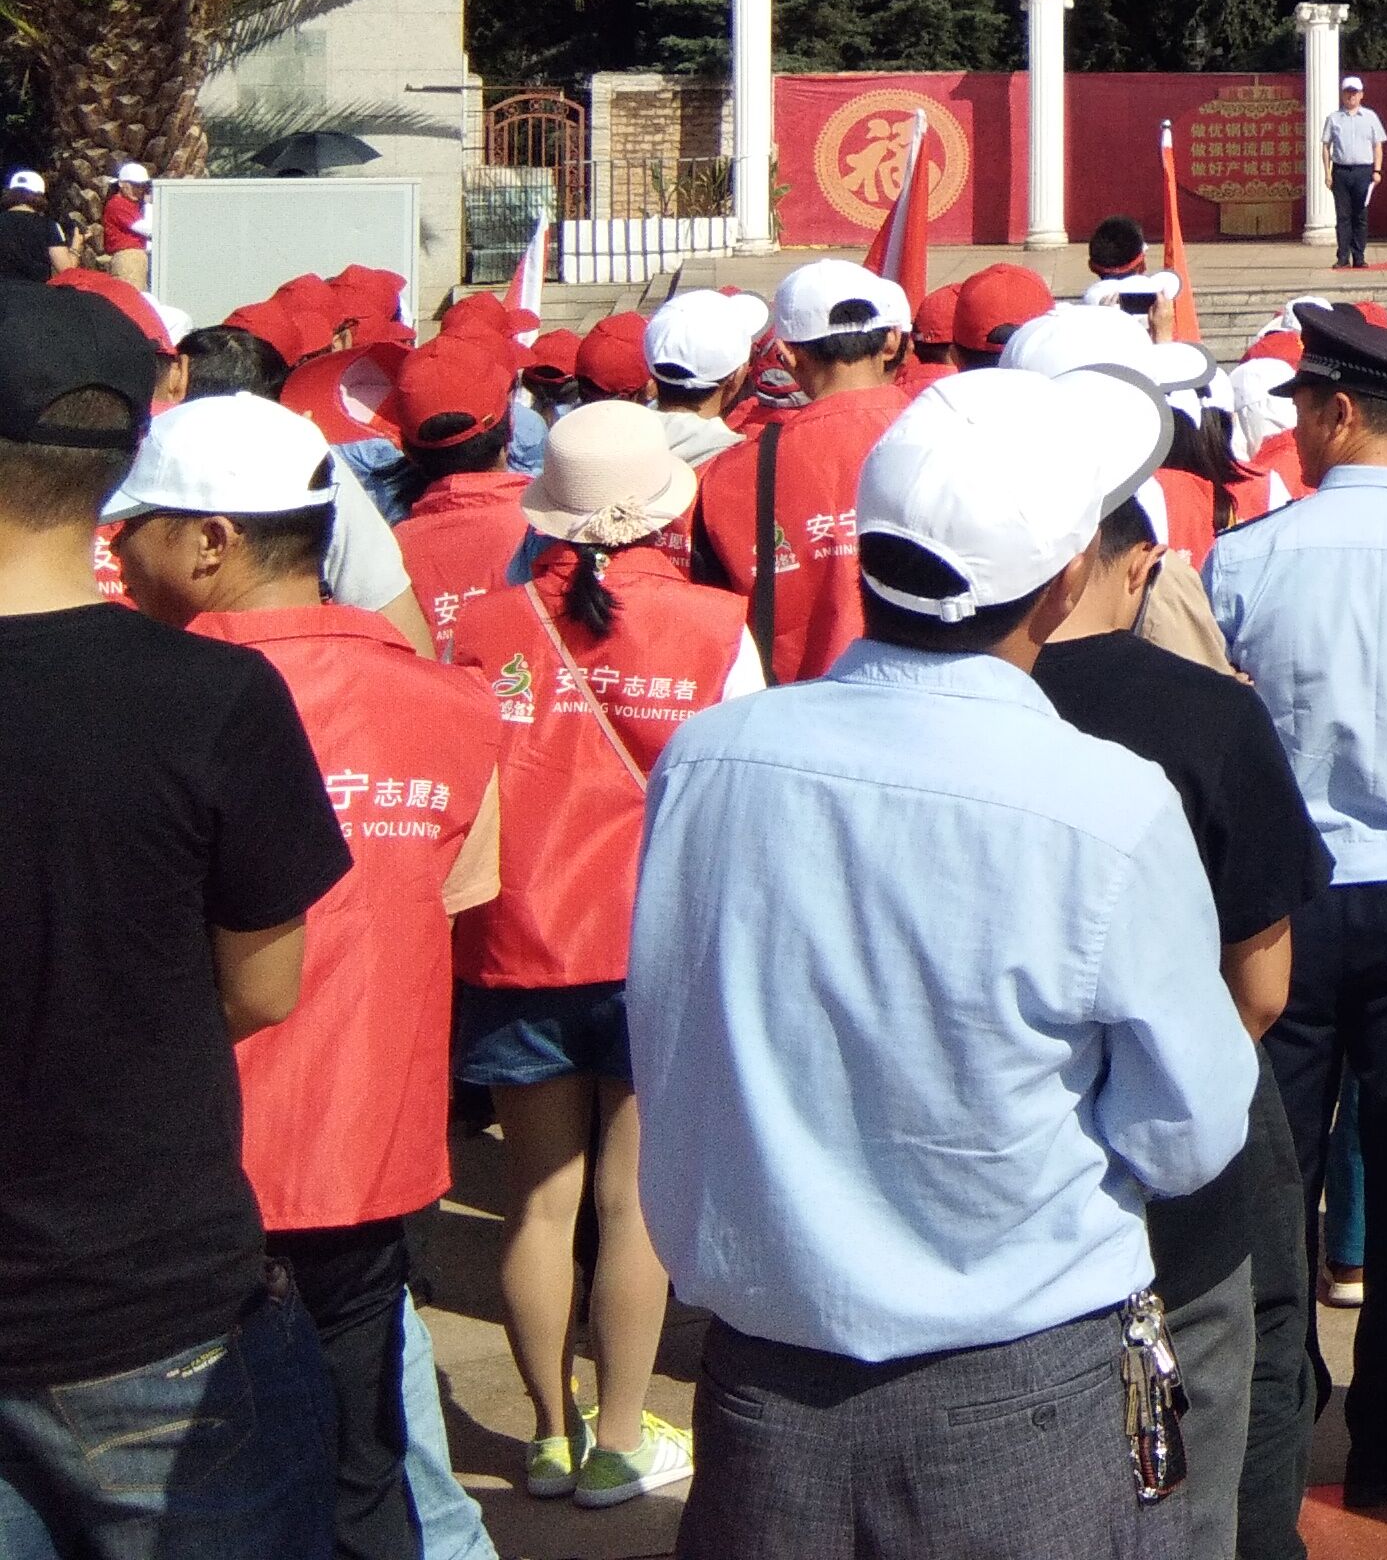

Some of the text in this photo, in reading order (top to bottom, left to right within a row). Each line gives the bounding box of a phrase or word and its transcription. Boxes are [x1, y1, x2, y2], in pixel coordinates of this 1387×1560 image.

[554, 665, 698, 702] 安宁志愿者
[553, 701, 610, 715] ANNIG
